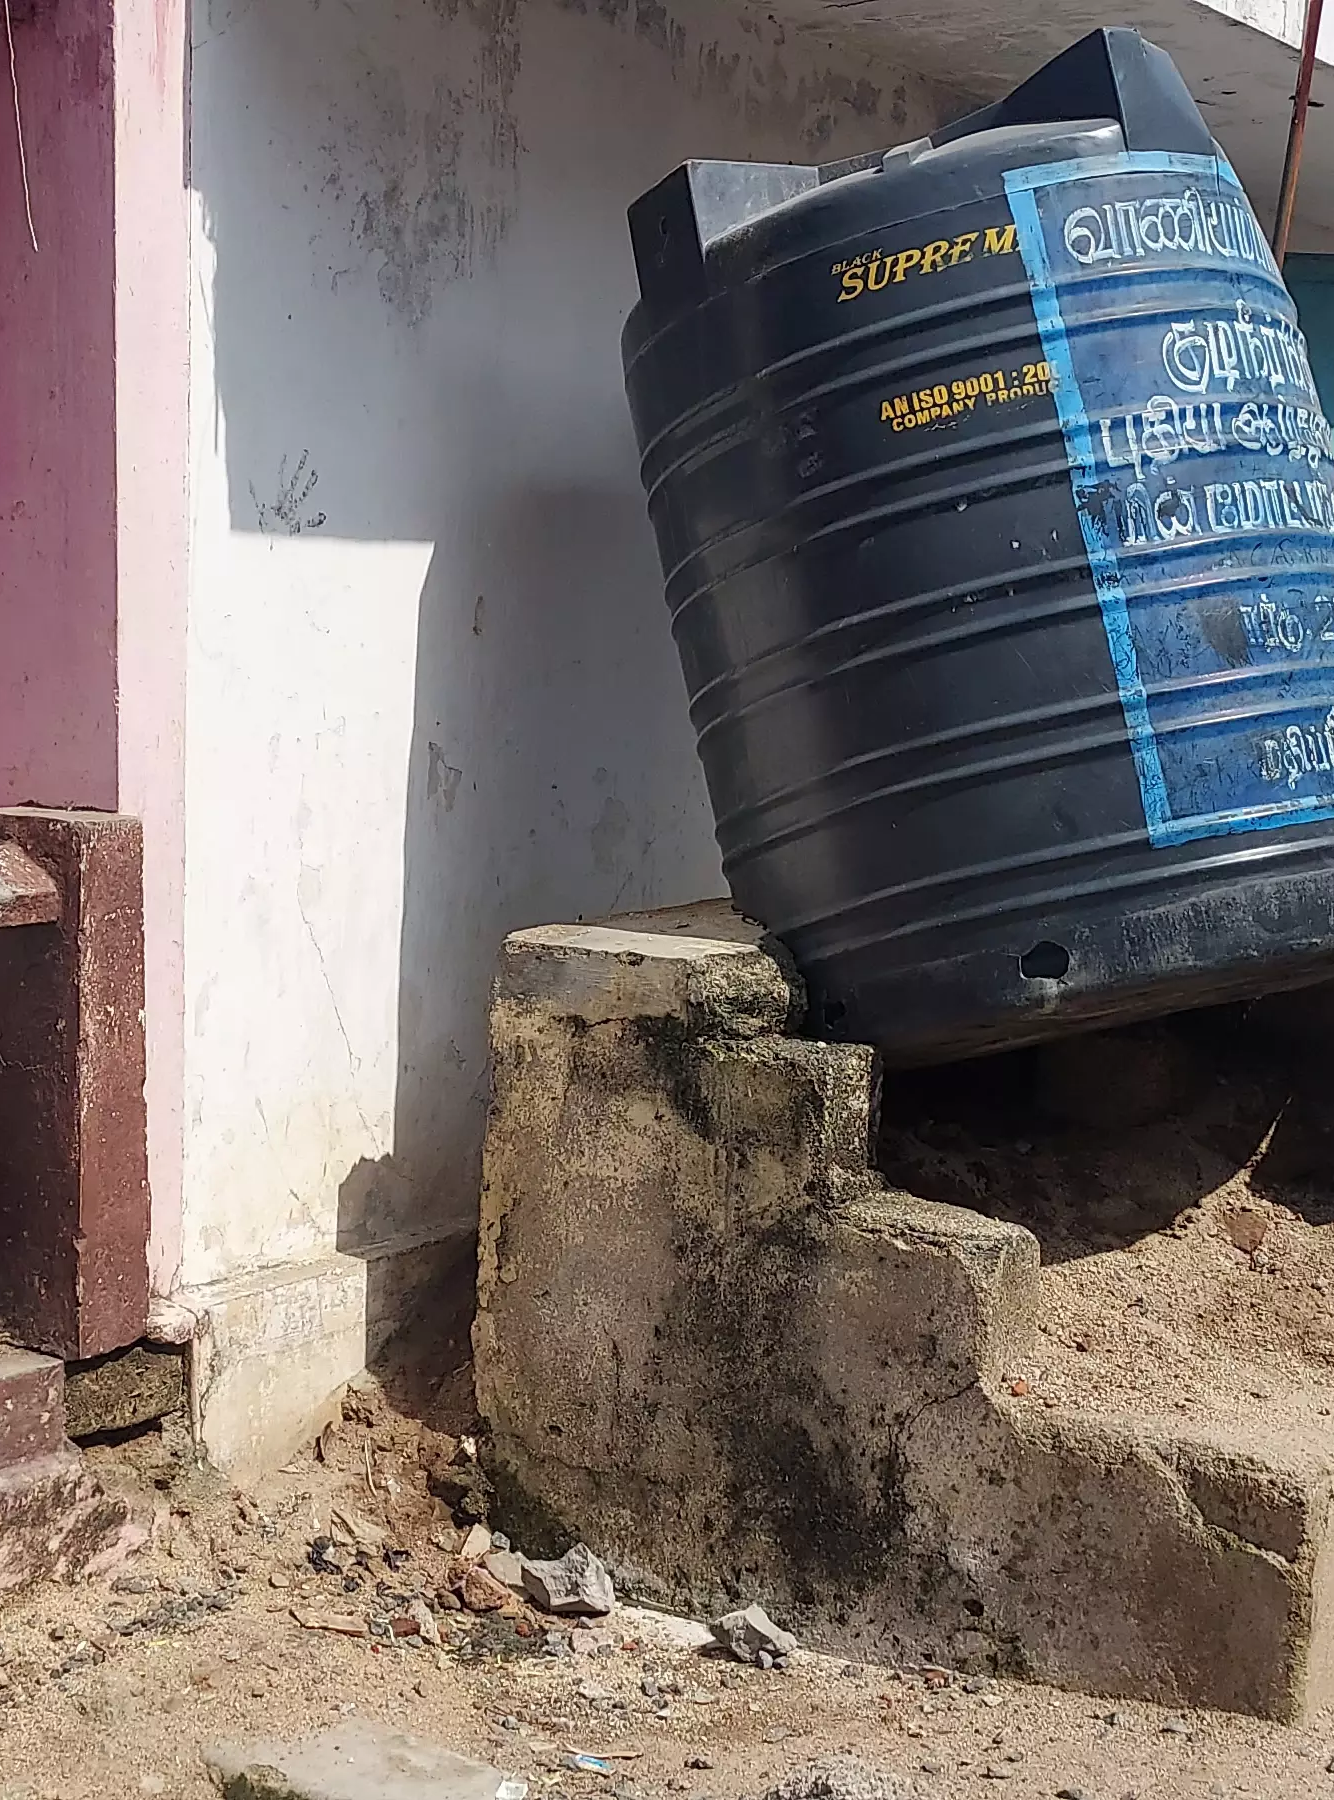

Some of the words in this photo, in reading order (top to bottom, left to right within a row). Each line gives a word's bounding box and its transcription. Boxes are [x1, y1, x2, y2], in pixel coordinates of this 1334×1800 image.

[831, 248, 883, 275] BLACK
[836, 223, 1020, 302] SUPREM
[880, 394, 908, 421] AN
[912, 385, 949, 411] ISO
[952, 370, 1005, 401] 9001
[892, 399, 976, 432] COMPANY
